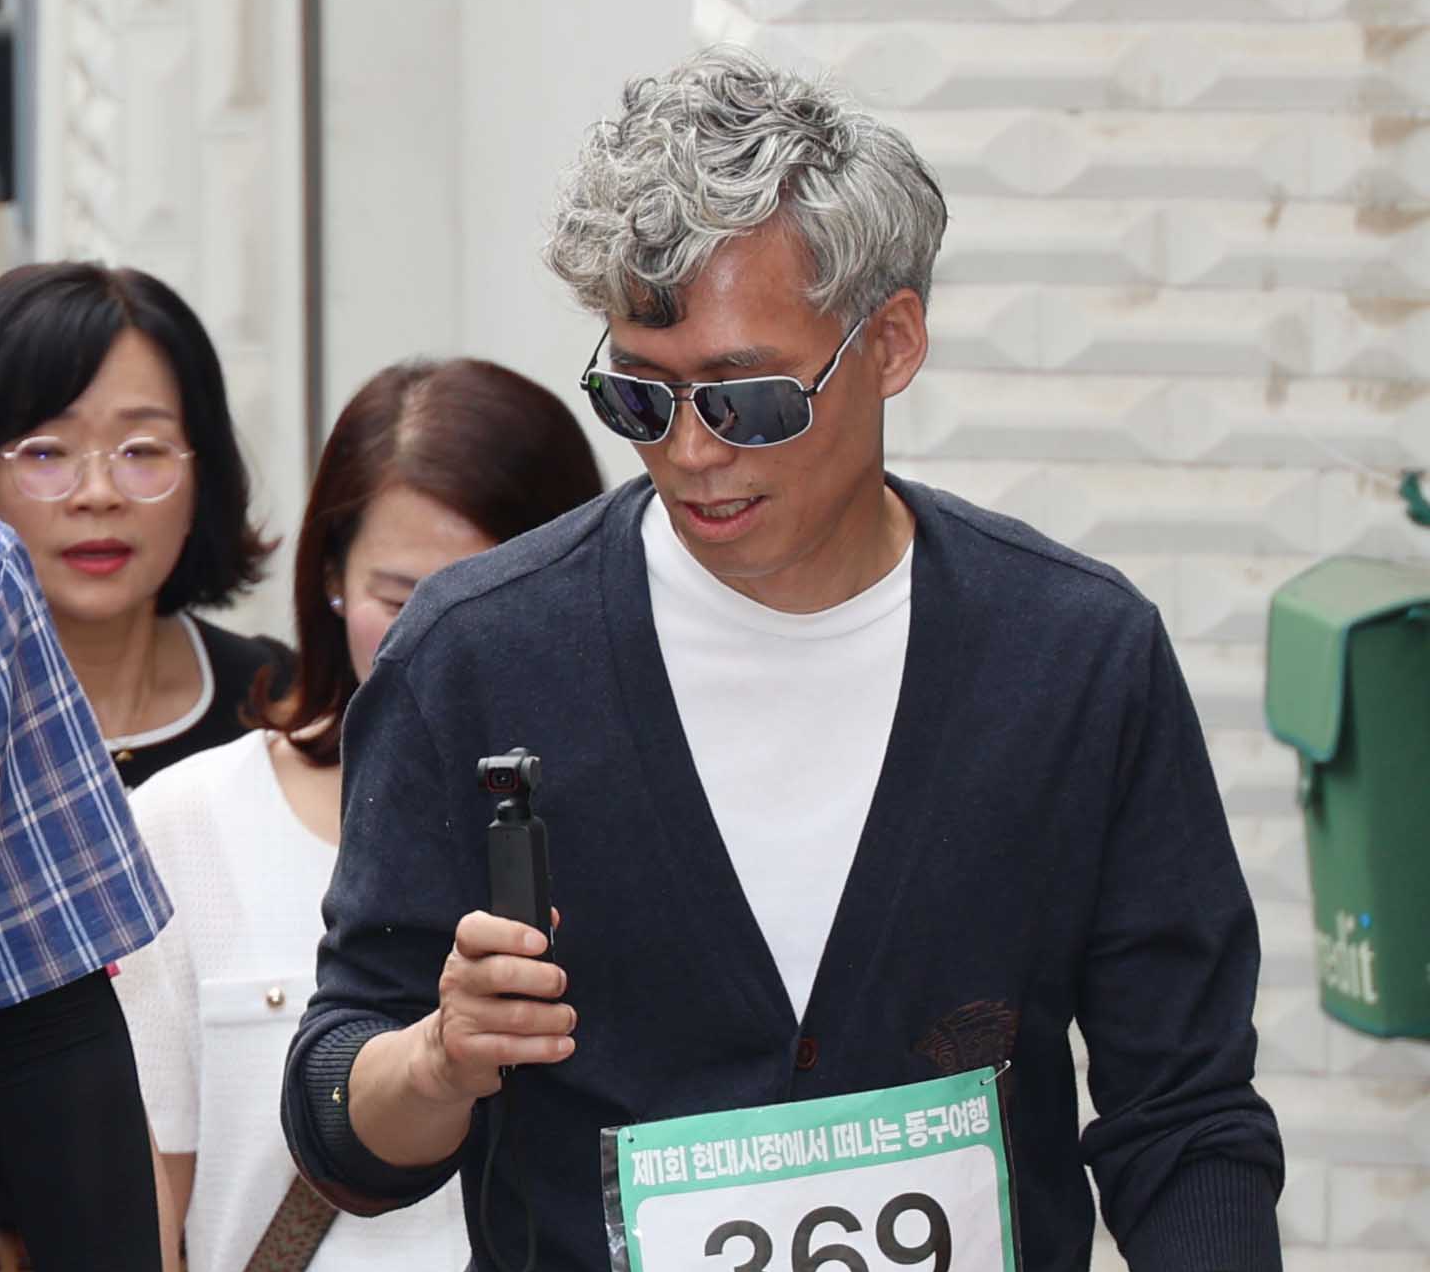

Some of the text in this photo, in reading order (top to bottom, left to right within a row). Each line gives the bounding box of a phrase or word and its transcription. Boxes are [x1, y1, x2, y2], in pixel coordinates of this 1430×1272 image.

[630, 1095, 990, 1186] 제1회 현대시장에서 떠나는 동구여행
